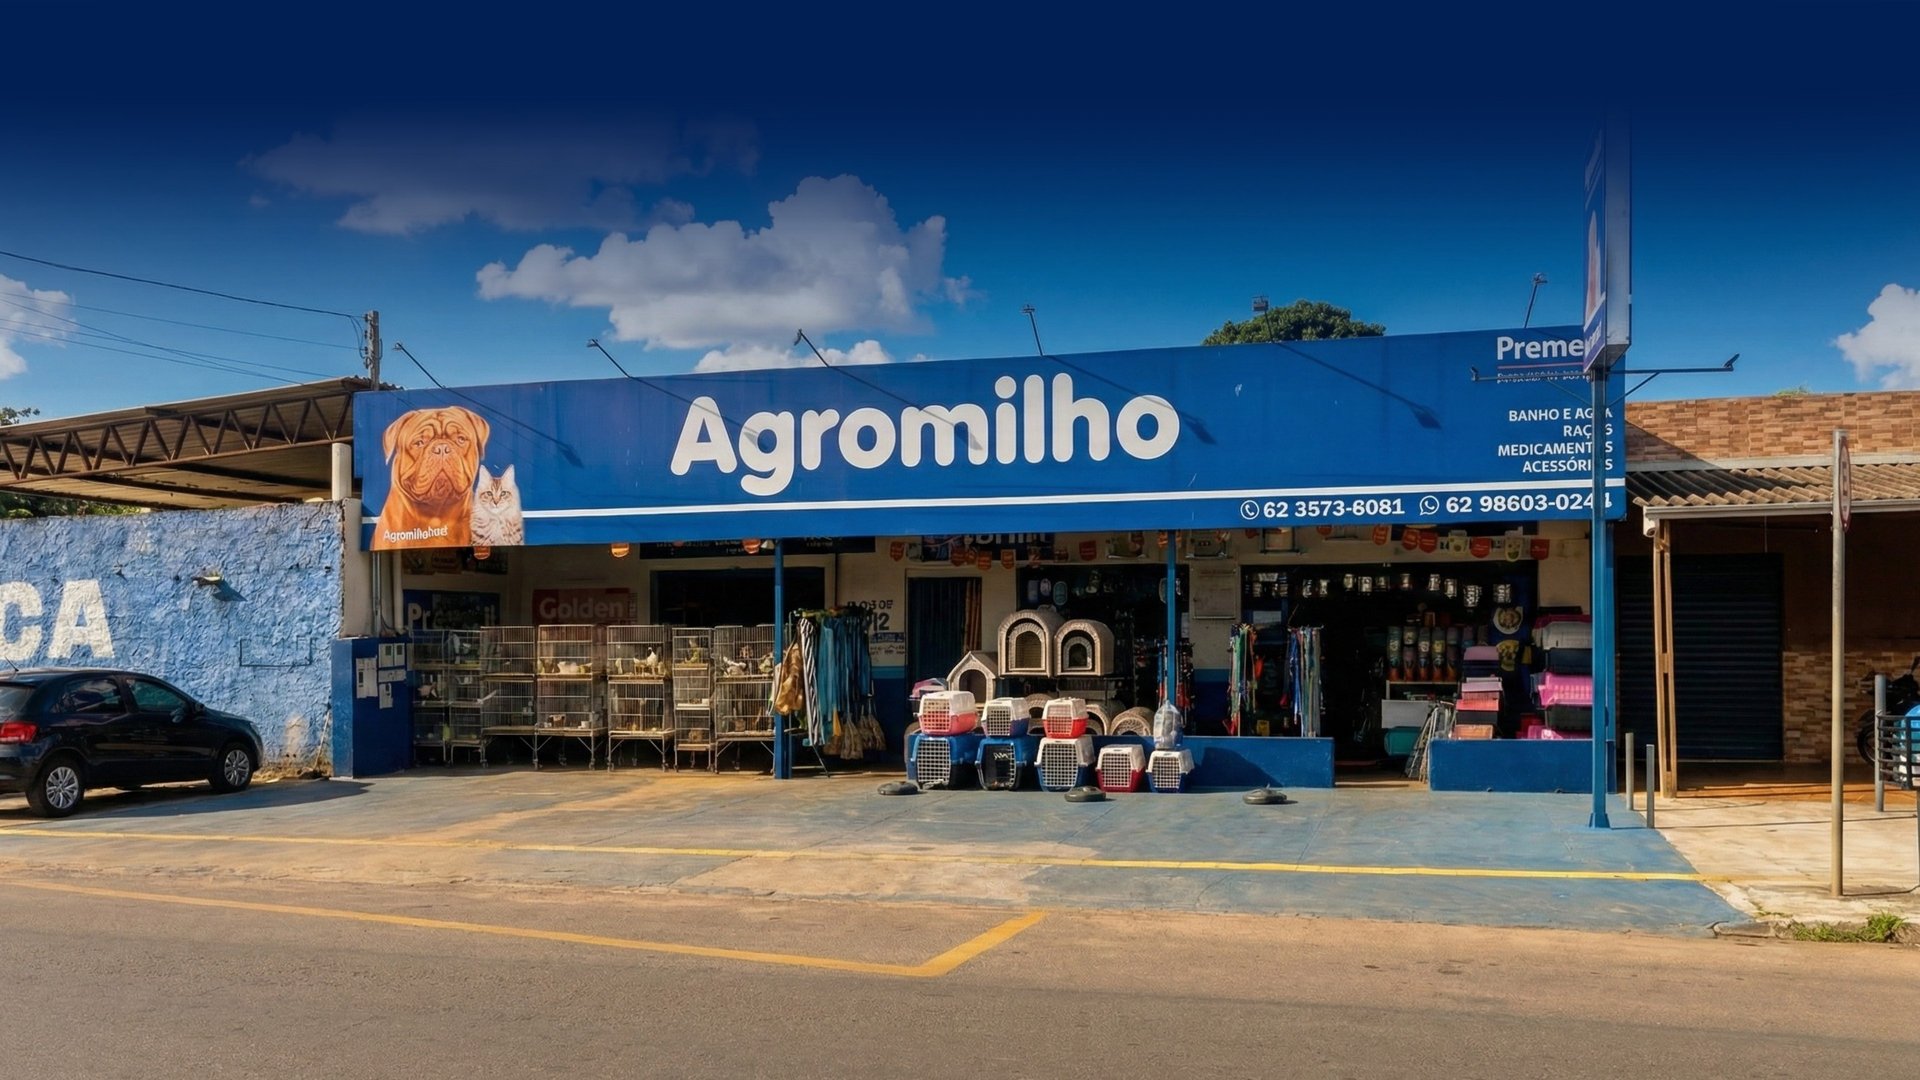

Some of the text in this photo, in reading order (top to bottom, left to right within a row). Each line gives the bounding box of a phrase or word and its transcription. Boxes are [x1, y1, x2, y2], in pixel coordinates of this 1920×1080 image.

[1509, 408, 1560, 422] BANHO
[1563, 408, 1572, 420] E
[670, 371, 1181, 497] Agromilho
[1563, 423, 1613, 439] RAÇS
[1498, 440, 1613, 457] MEDICAMENTS
[1522, 456, 1613, 473] ACESSÓRIS
[1263, 497, 1405, 518] 62 3573-6081
[1446, 496, 1472, 514] 62
[539, 596, 624, 620] Golden
